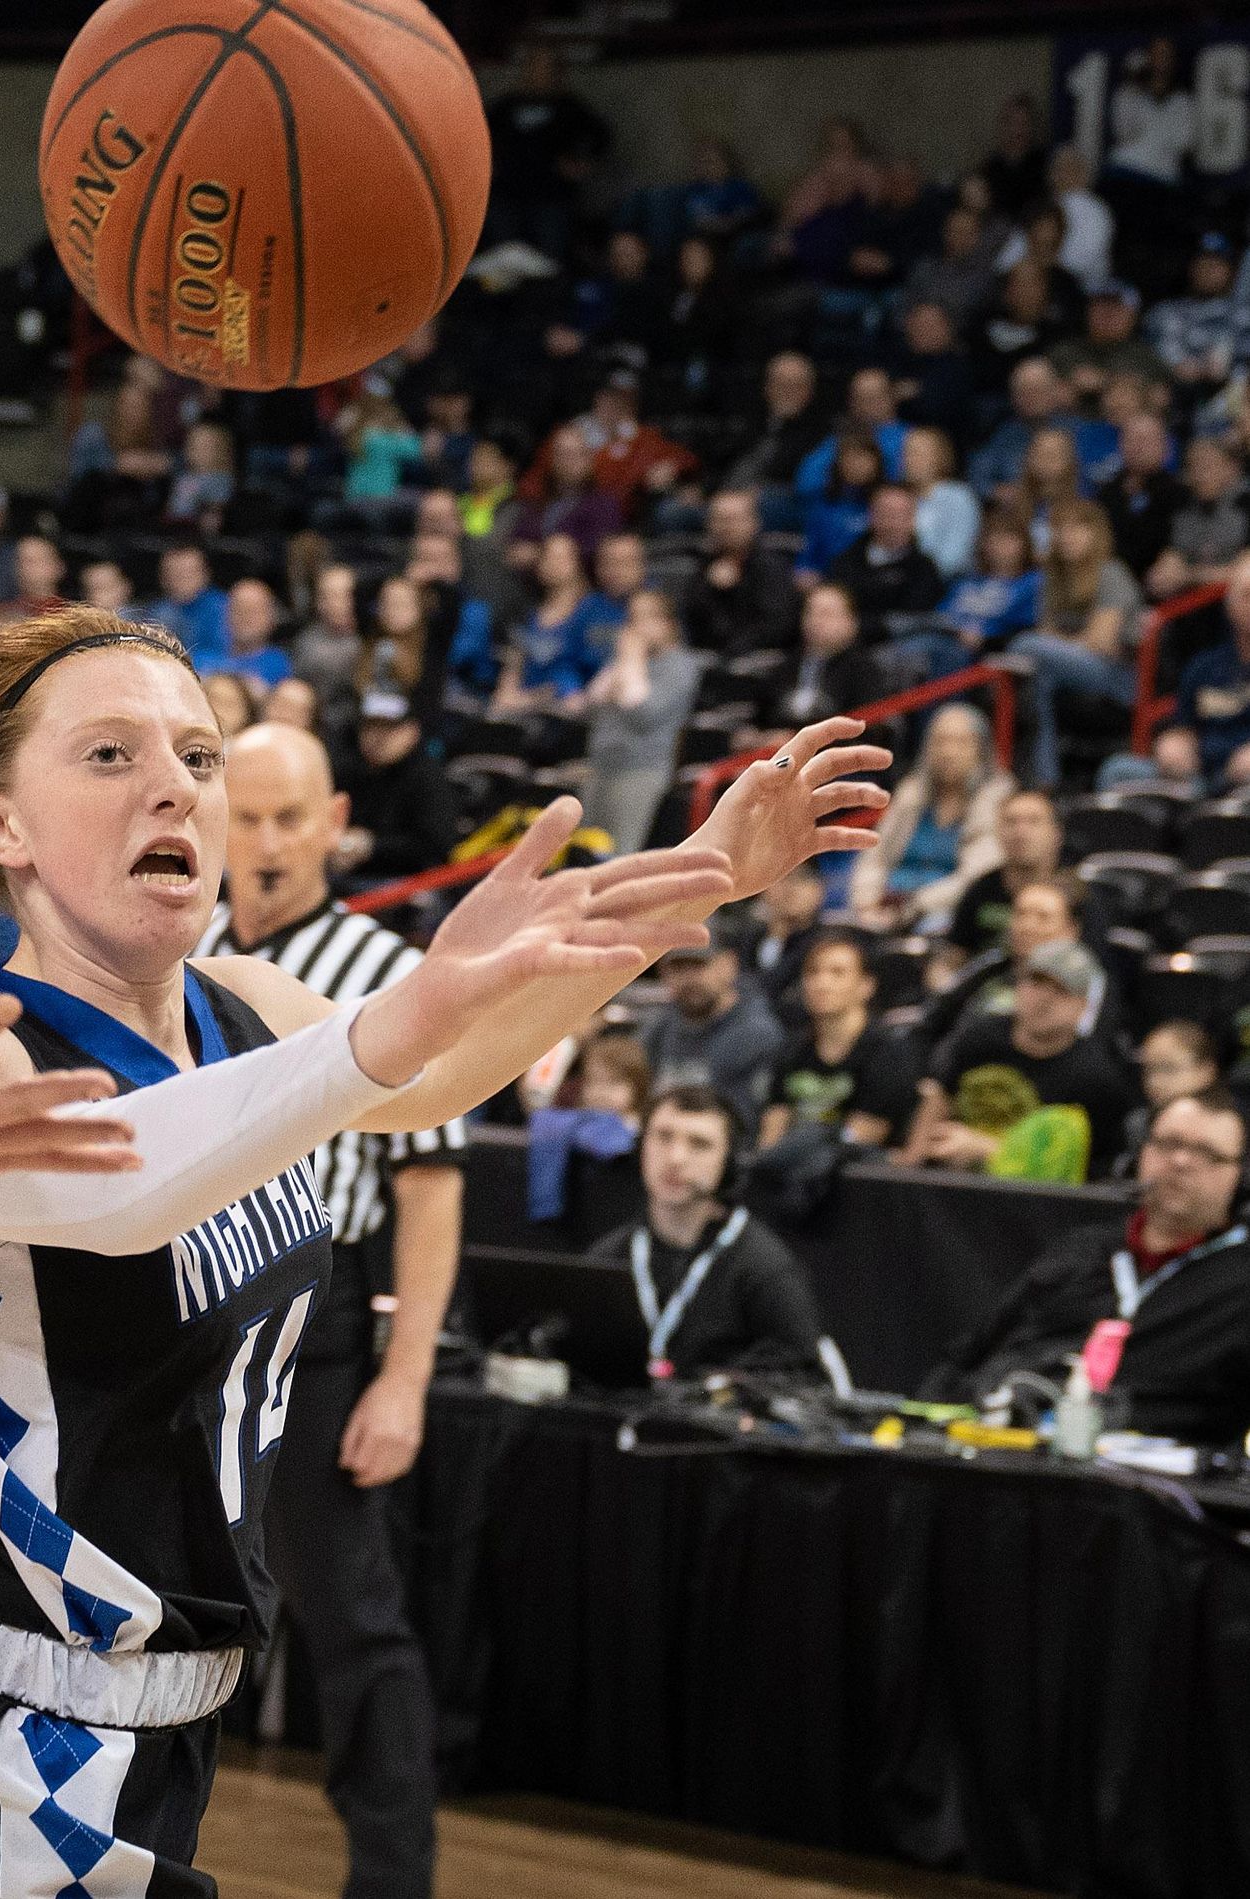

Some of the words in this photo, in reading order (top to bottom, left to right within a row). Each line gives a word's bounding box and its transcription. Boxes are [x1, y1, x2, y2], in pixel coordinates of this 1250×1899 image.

[1067, 47, 1249, 173] 16
[172, 178, 233, 342] 1000
[217, 1284, 317, 1527] 14
